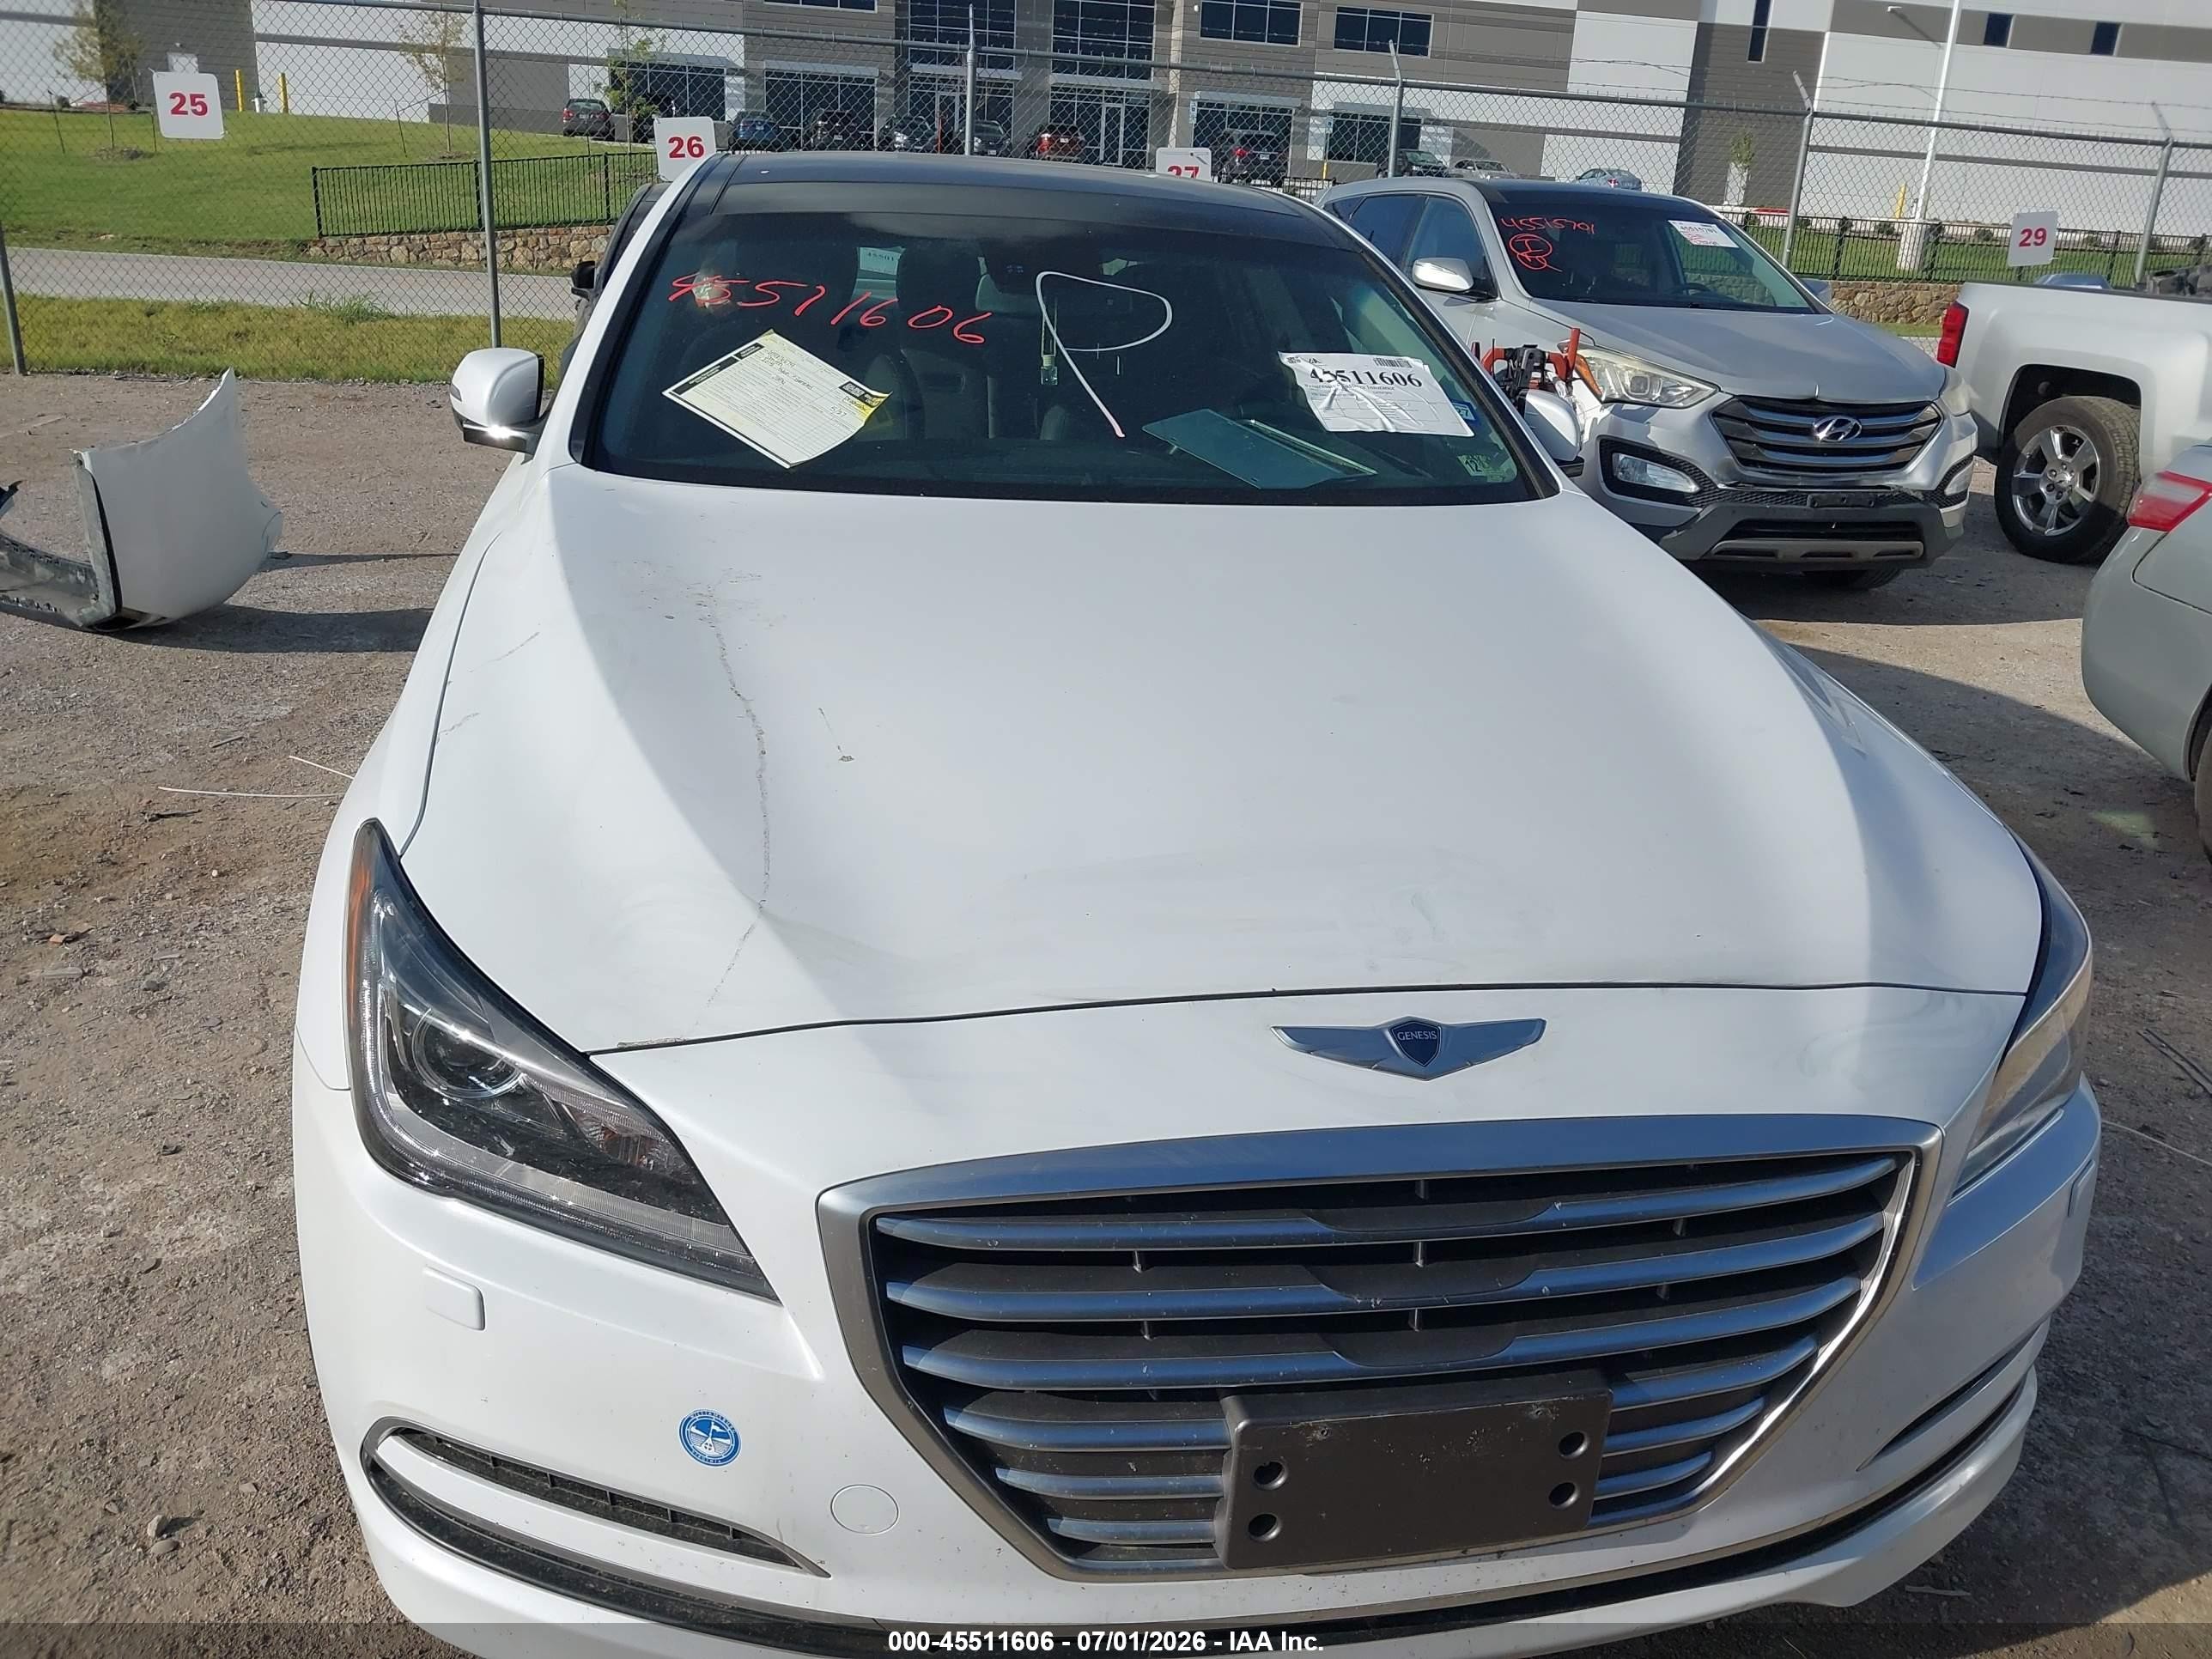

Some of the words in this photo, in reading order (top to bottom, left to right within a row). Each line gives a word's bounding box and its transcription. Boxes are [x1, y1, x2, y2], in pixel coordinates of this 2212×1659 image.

[168, 92, 208, 117] 25
[668, 136, 705, 159] 26
[1501, 217, 1595, 234] 45515701
[2019, 228, 2047, 247] 29
[1310, 368, 1422, 387] 45511606
[1396, 1031, 1437, 1041] GENESIS
